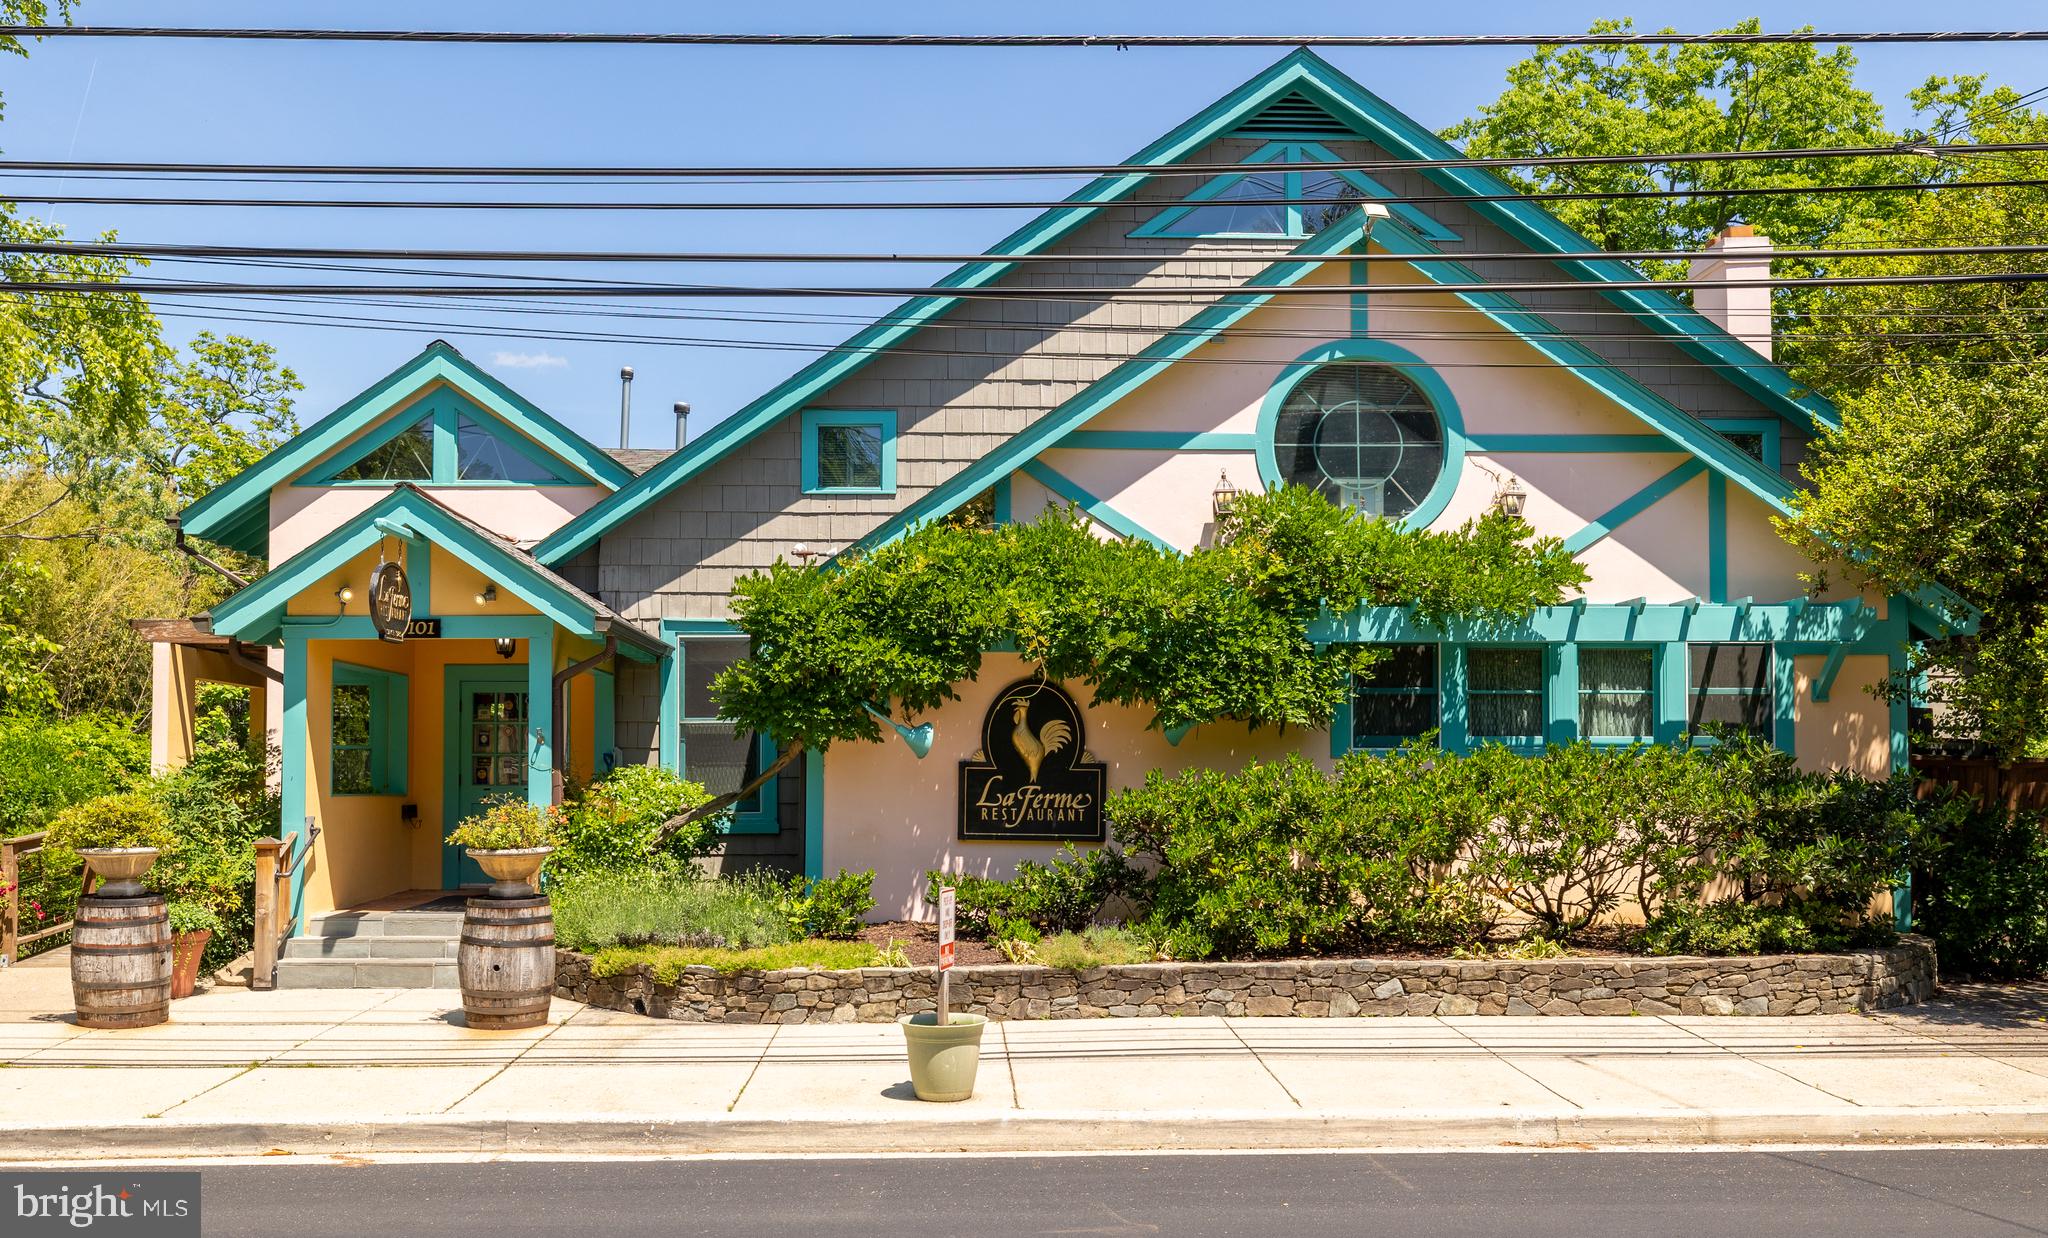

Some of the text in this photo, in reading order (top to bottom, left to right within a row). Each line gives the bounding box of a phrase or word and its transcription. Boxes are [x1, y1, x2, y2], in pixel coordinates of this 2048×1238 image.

[407, 621, 435, 635] 101
[976, 775, 1092, 828] La Ferme
[981, 807, 1085, 822] RESTAURANT
